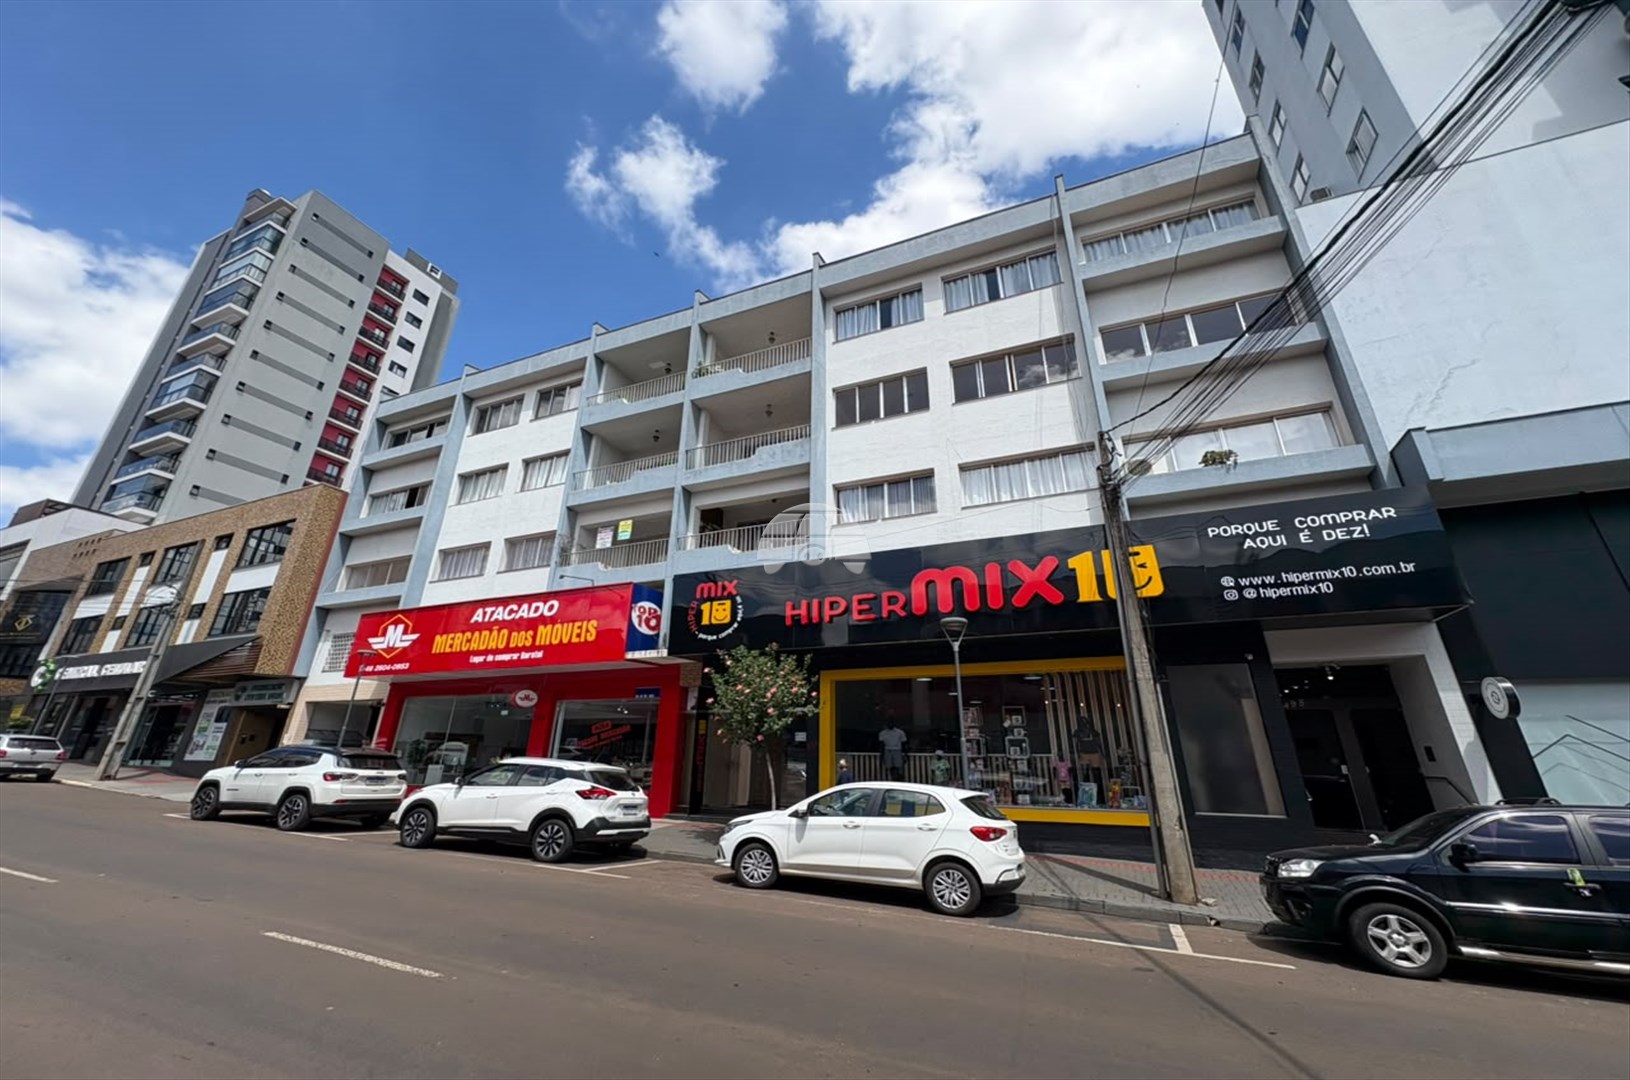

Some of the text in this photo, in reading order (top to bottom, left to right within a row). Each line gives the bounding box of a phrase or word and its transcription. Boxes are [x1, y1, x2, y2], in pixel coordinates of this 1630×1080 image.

[1207, 507, 1397, 538] PORQUE COMPRAR
[1243, 523, 1371, 550] AQUI É DEZ!
[1237, 561, 1416, 586] www.hipermix10.com.br
[695, 579, 738, 599] MIX
[470, 600, 559, 624] ATACADO
[431, 619, 598, 654] MERCADÃO DOS MÓVEIS
